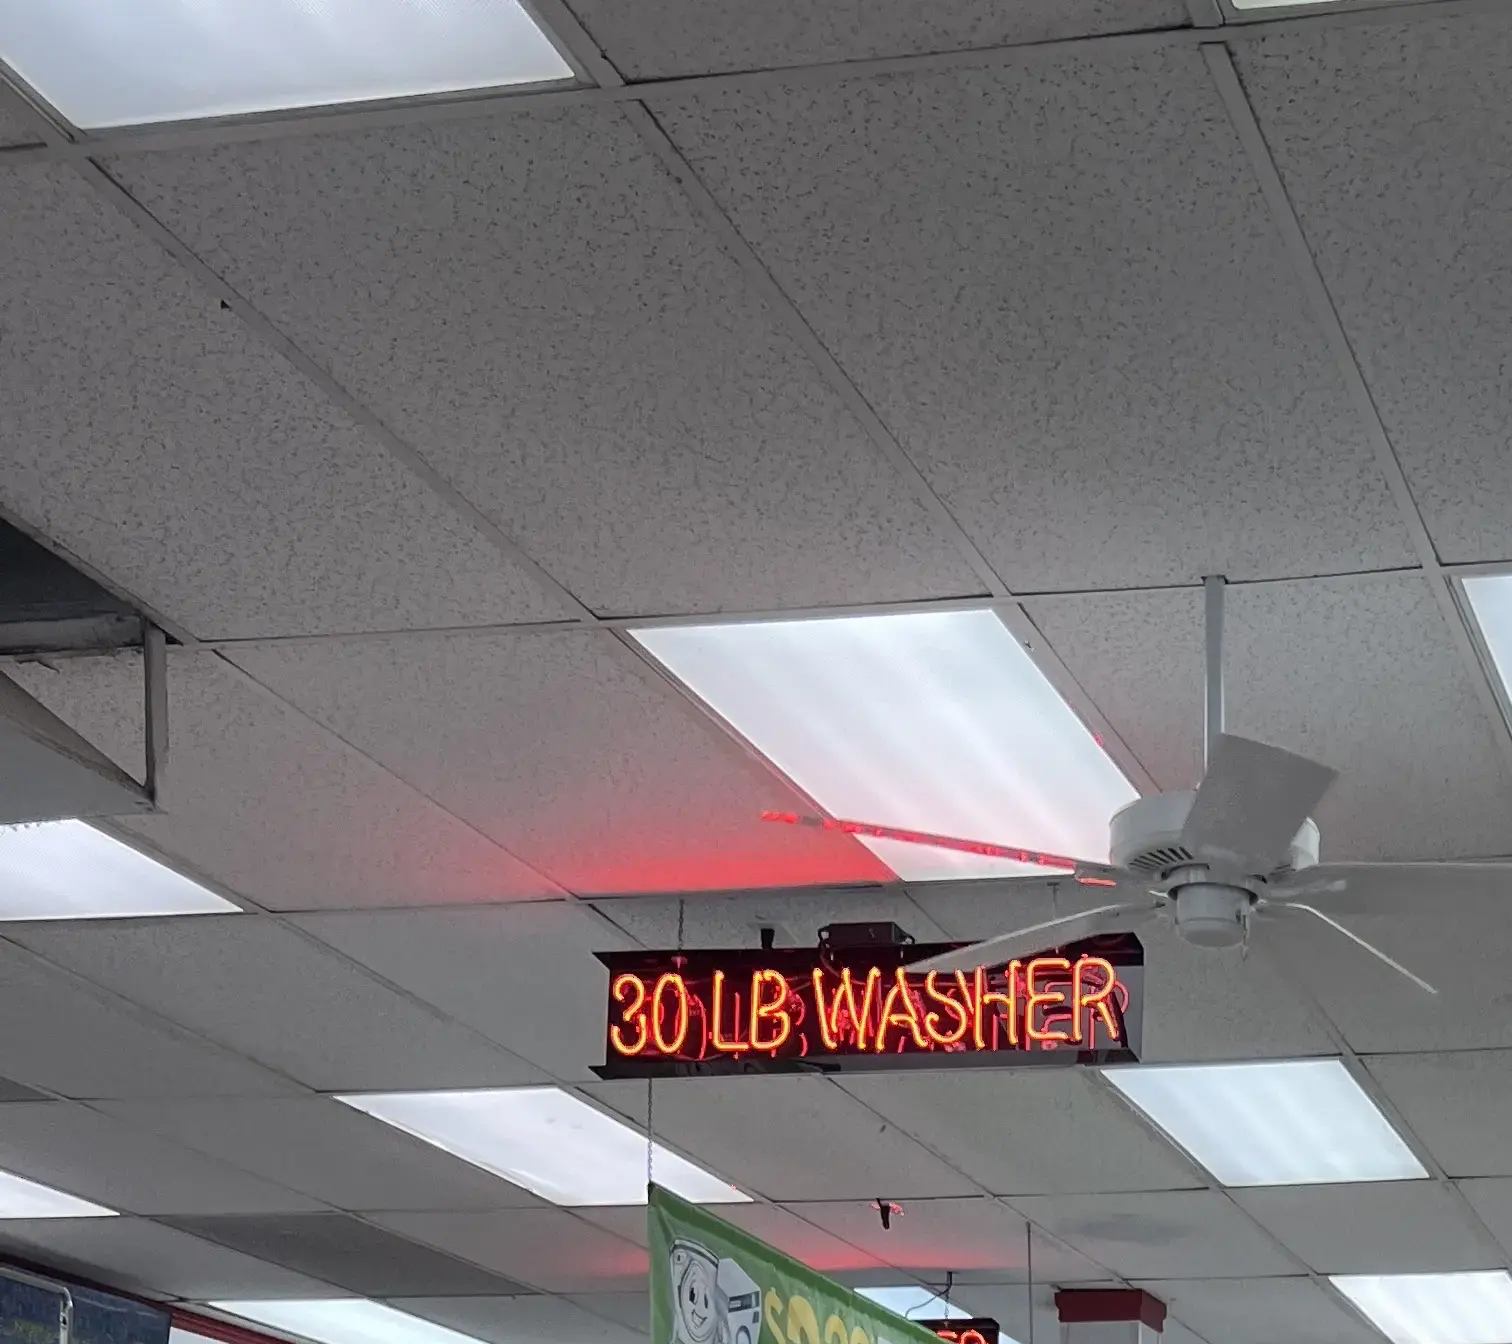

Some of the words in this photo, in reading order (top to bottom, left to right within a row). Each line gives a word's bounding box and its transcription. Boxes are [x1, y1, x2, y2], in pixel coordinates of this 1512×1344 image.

[610, 972, 687, 1055] 30
[711, 969, 793, 1050] LB
[812, 957, 1121, 1052] WASHER
